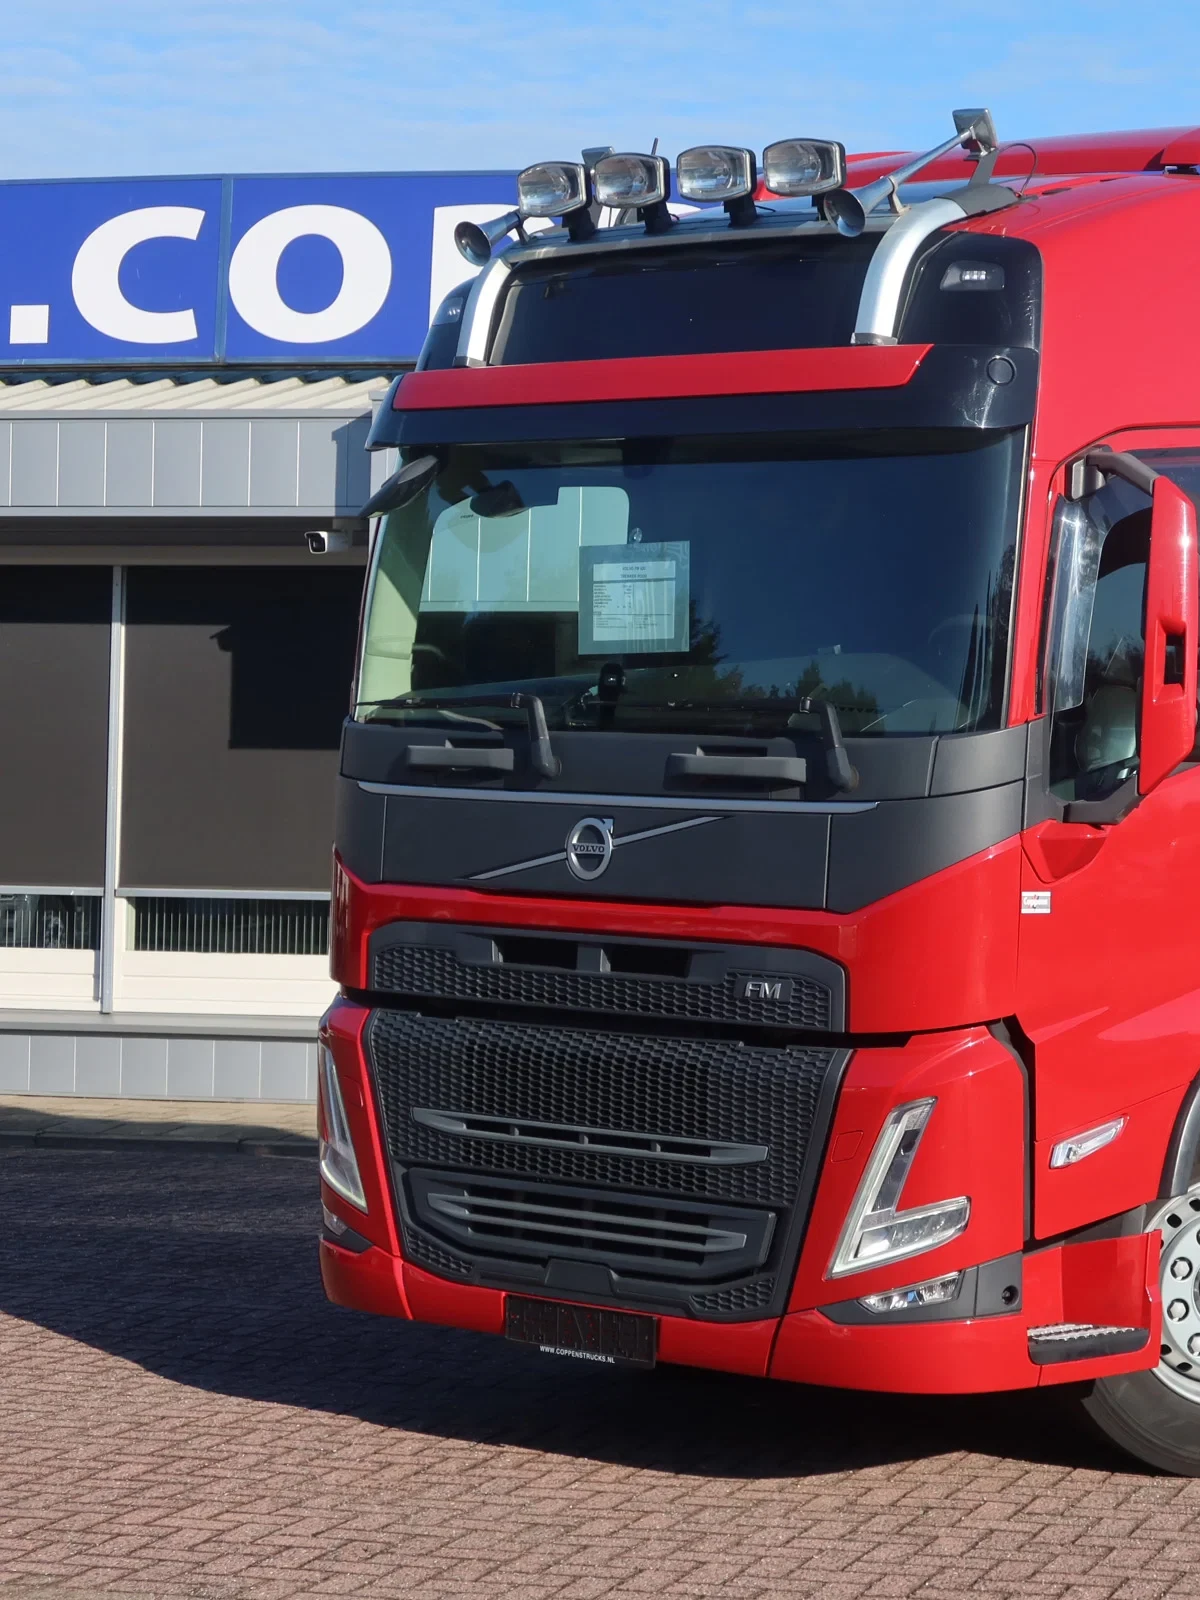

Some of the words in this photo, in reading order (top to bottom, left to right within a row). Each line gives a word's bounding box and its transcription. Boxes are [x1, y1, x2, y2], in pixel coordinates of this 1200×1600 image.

[572, 844, 605, 853] VOLVO
[744, 981, 782, 1000] FM
[540, 1345, 615, 1363] WWW.COPPENSTRUCKS.NL
